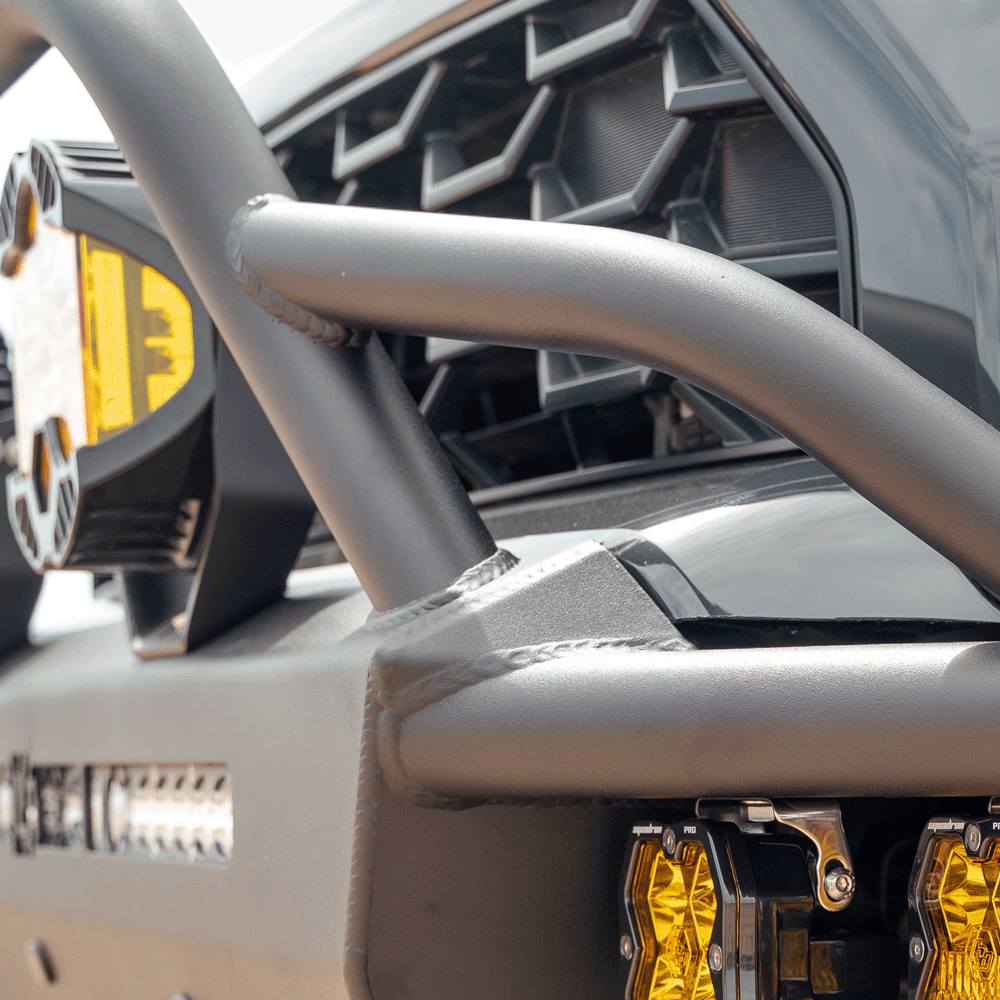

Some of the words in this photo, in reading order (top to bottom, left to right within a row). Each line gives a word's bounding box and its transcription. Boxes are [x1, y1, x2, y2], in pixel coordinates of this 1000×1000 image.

[632, 823, 663, 837] squadron
[683, 826, 697, 834] PRO
[928, 819, 965, 833] squadron
